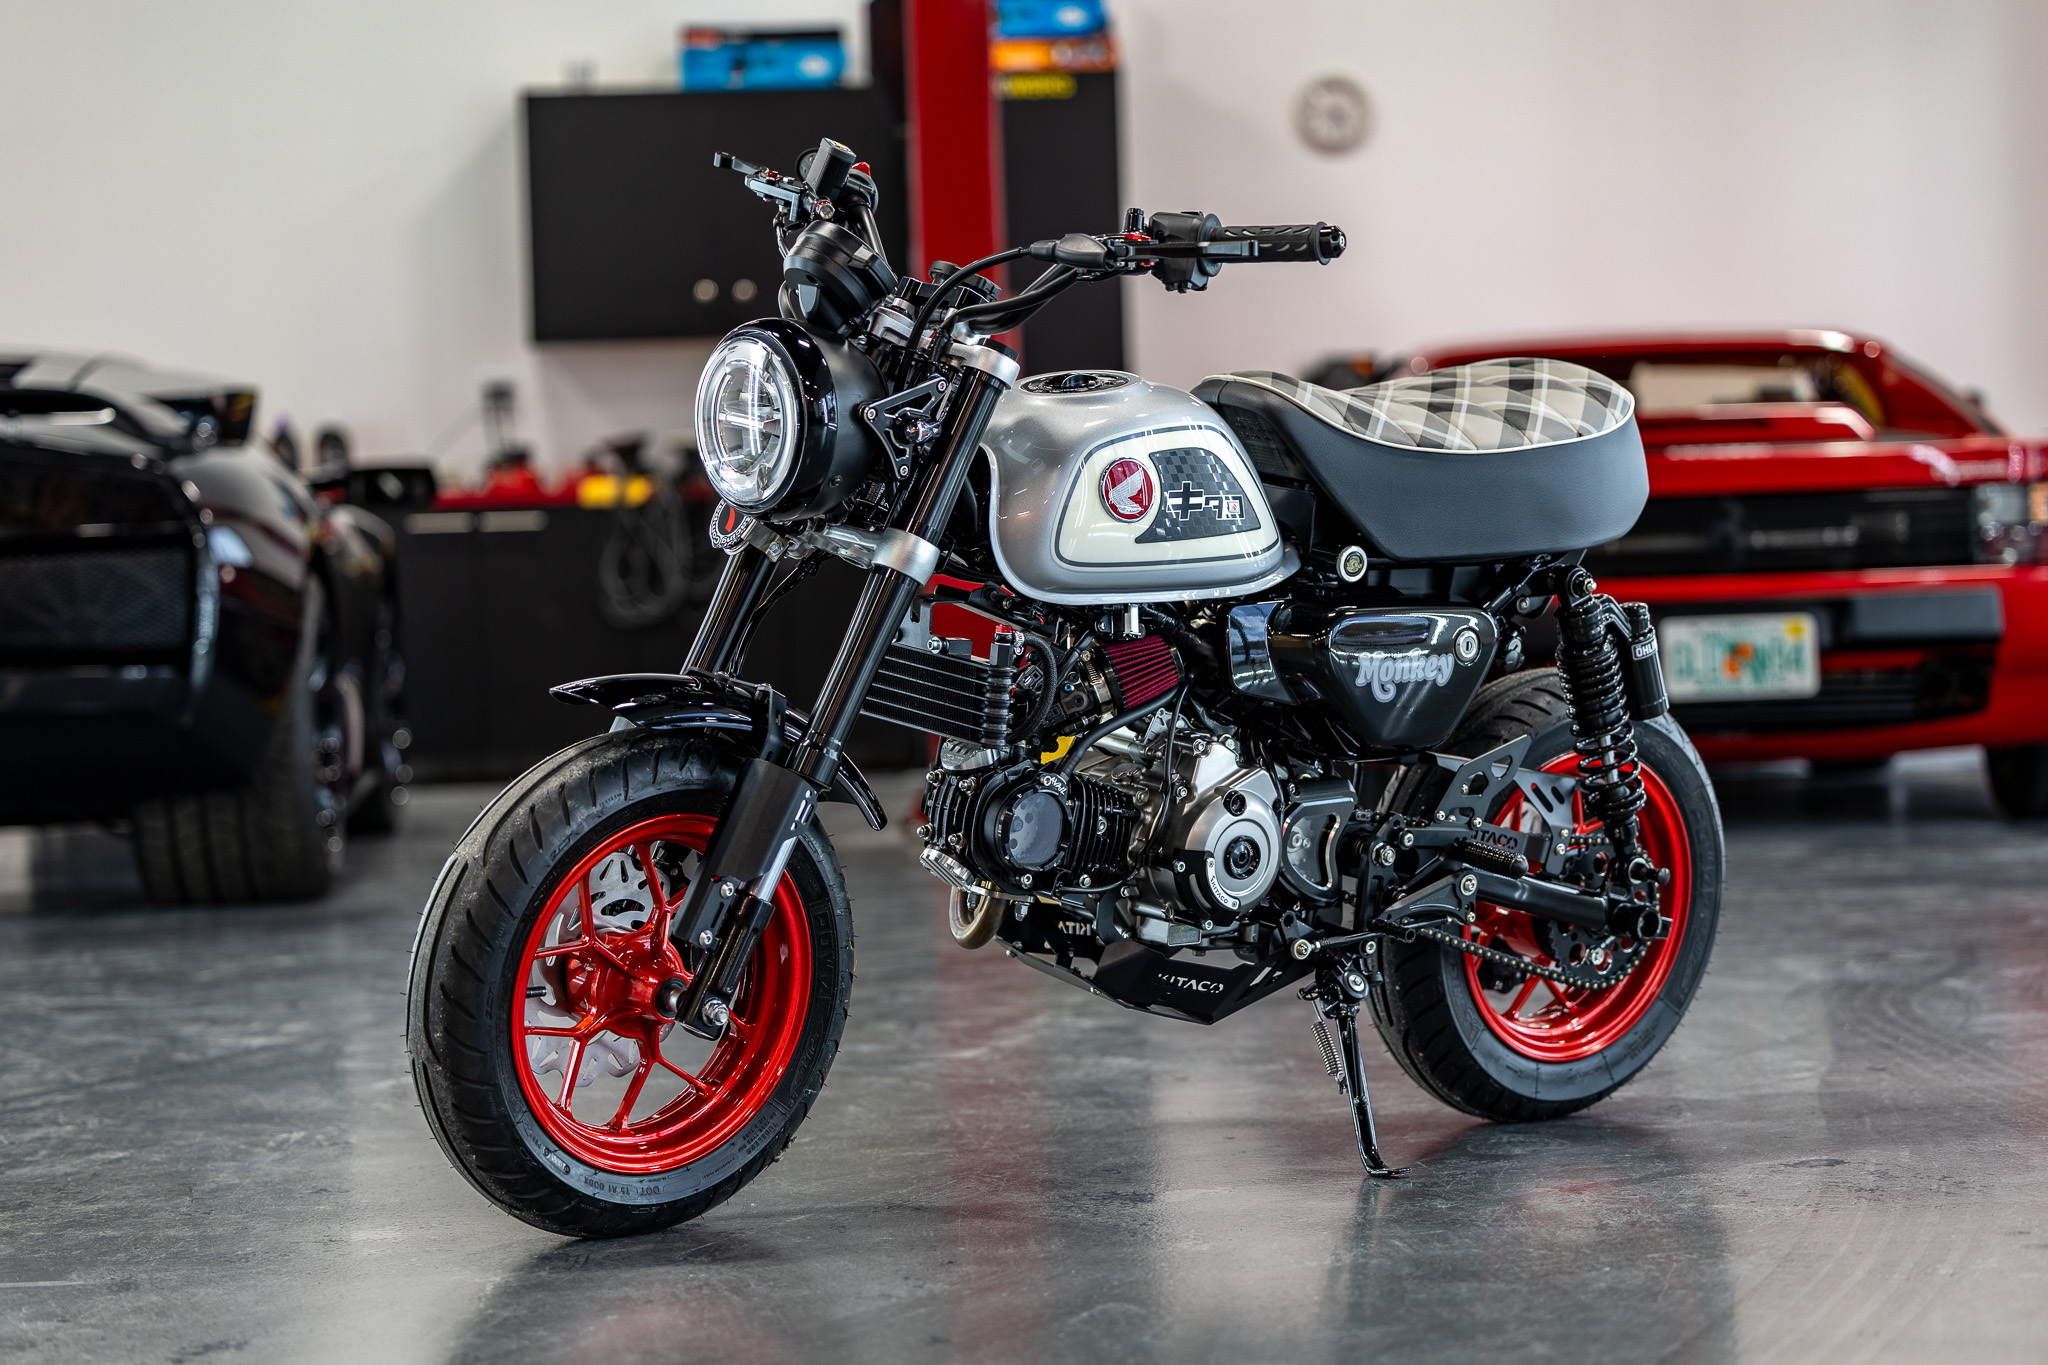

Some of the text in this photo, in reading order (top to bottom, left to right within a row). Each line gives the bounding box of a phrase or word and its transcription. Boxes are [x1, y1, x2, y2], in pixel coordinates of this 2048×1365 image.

[1355, 647, 1454, 703] Monkey
[1470, 830, 1518, 850] ITACO
[1210, 880, 1229, 904] KITACO
[641, 1185, 660, 1196] DOT
